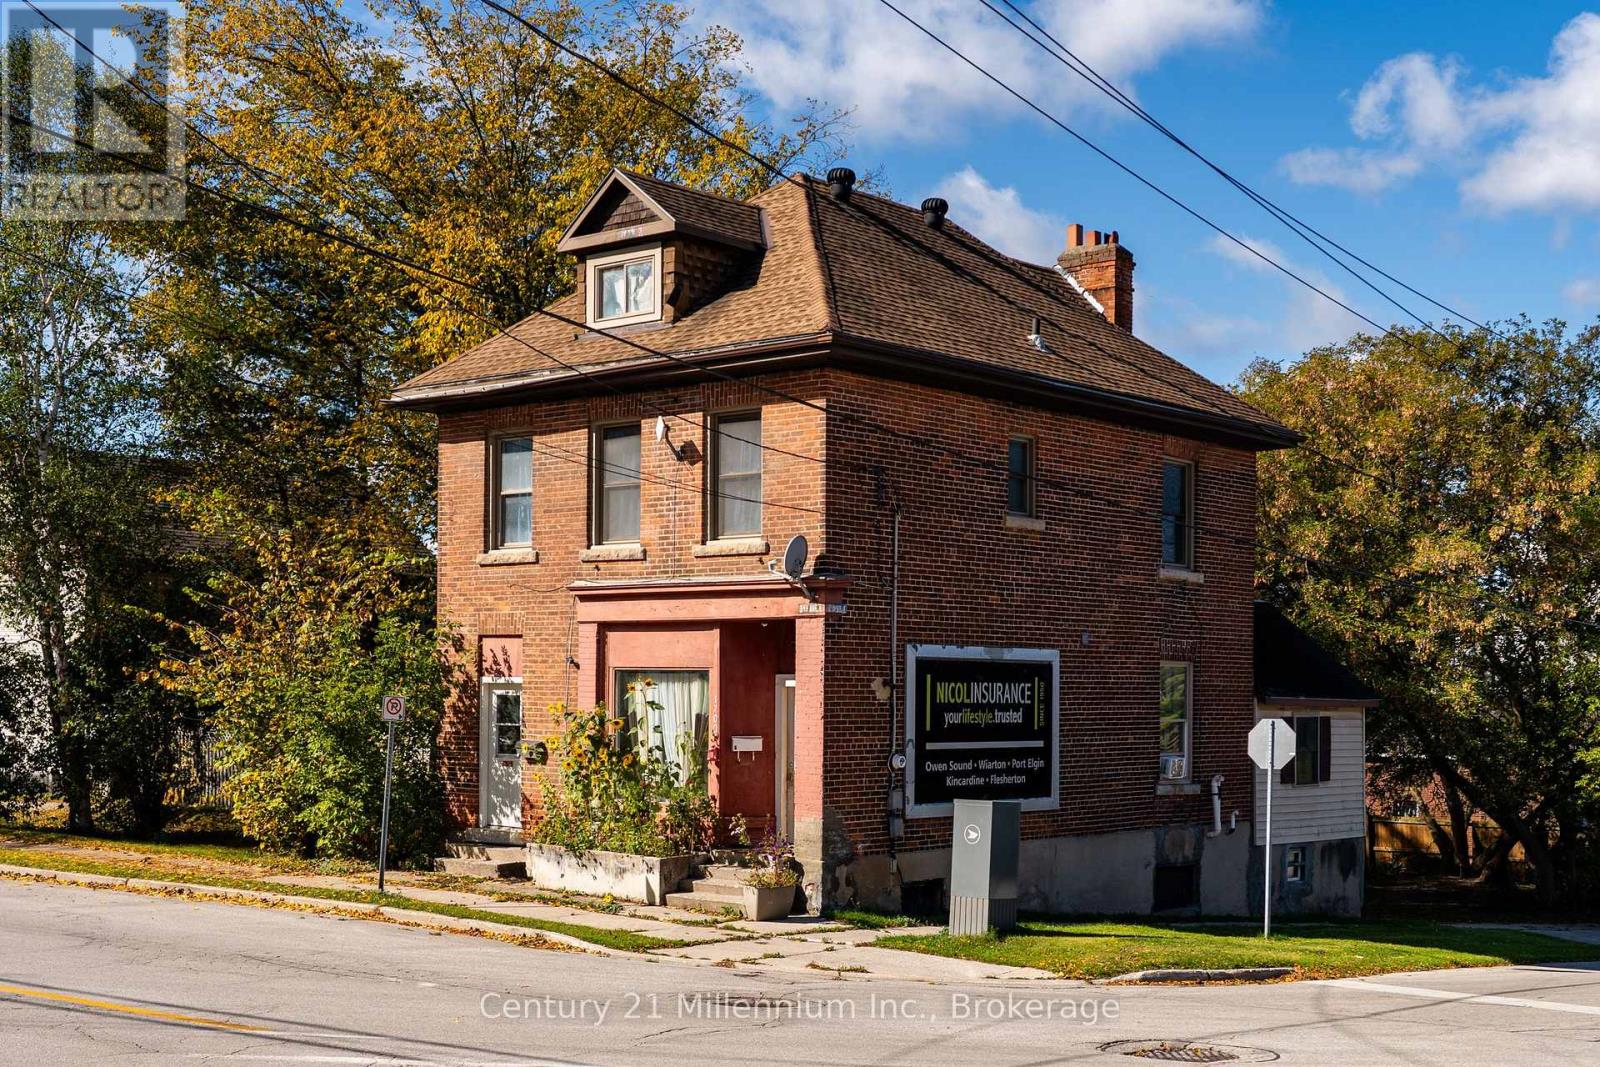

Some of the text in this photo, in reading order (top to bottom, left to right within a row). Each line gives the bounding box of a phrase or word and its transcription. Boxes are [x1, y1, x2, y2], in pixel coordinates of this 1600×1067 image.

[925, 757, 1045, 772] Owen Sound Wiarton Port Elgin
[946, 774, 1026, 787] Kincardine Flesherton
